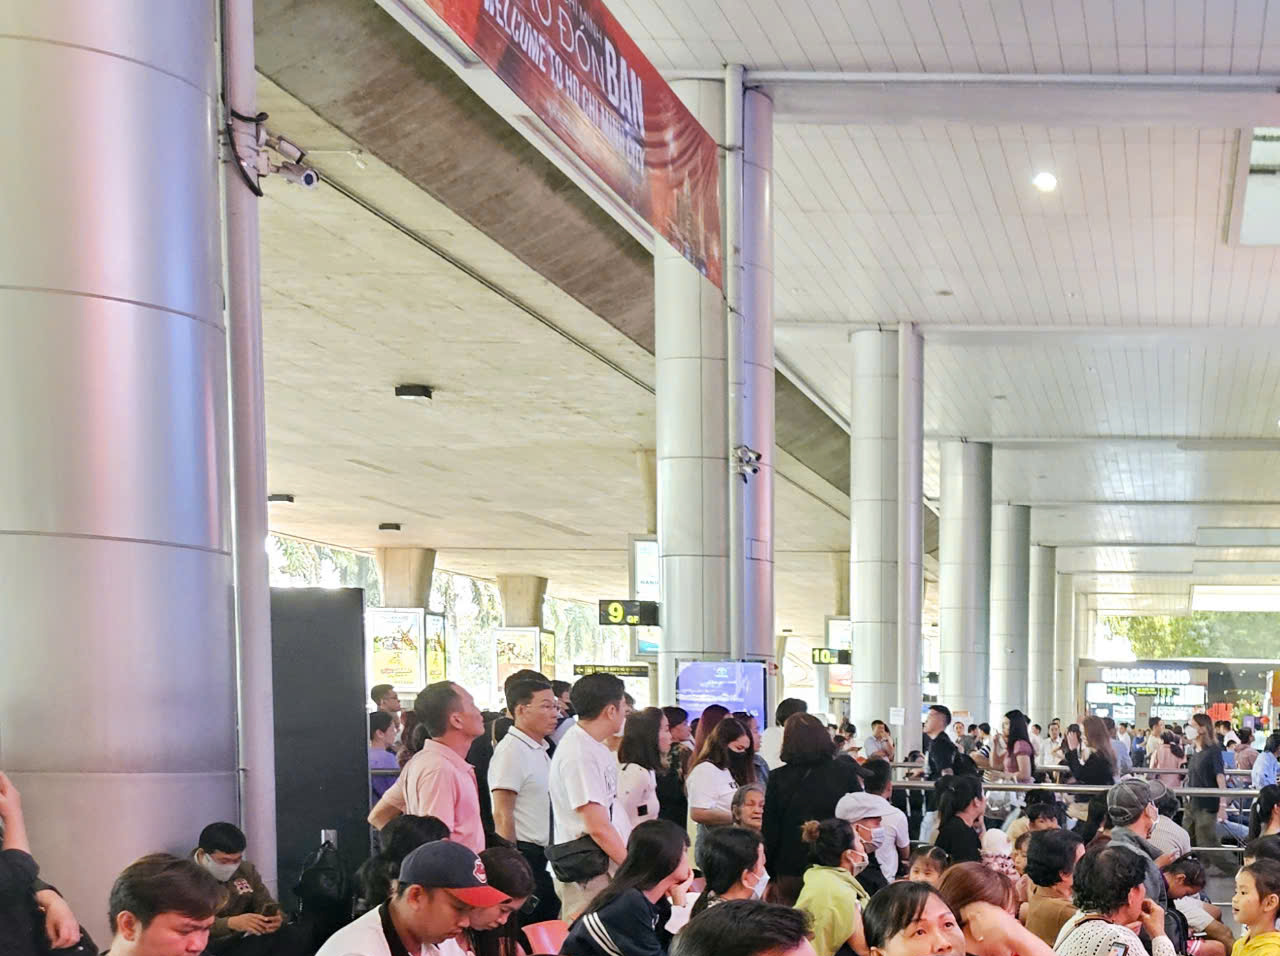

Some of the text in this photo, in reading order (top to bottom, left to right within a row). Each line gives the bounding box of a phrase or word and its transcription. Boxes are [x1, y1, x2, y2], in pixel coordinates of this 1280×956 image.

[547, 45, 564, 90] TO
[608, 602, 624, 623] 9
[813, 649, 831, 664] 10
